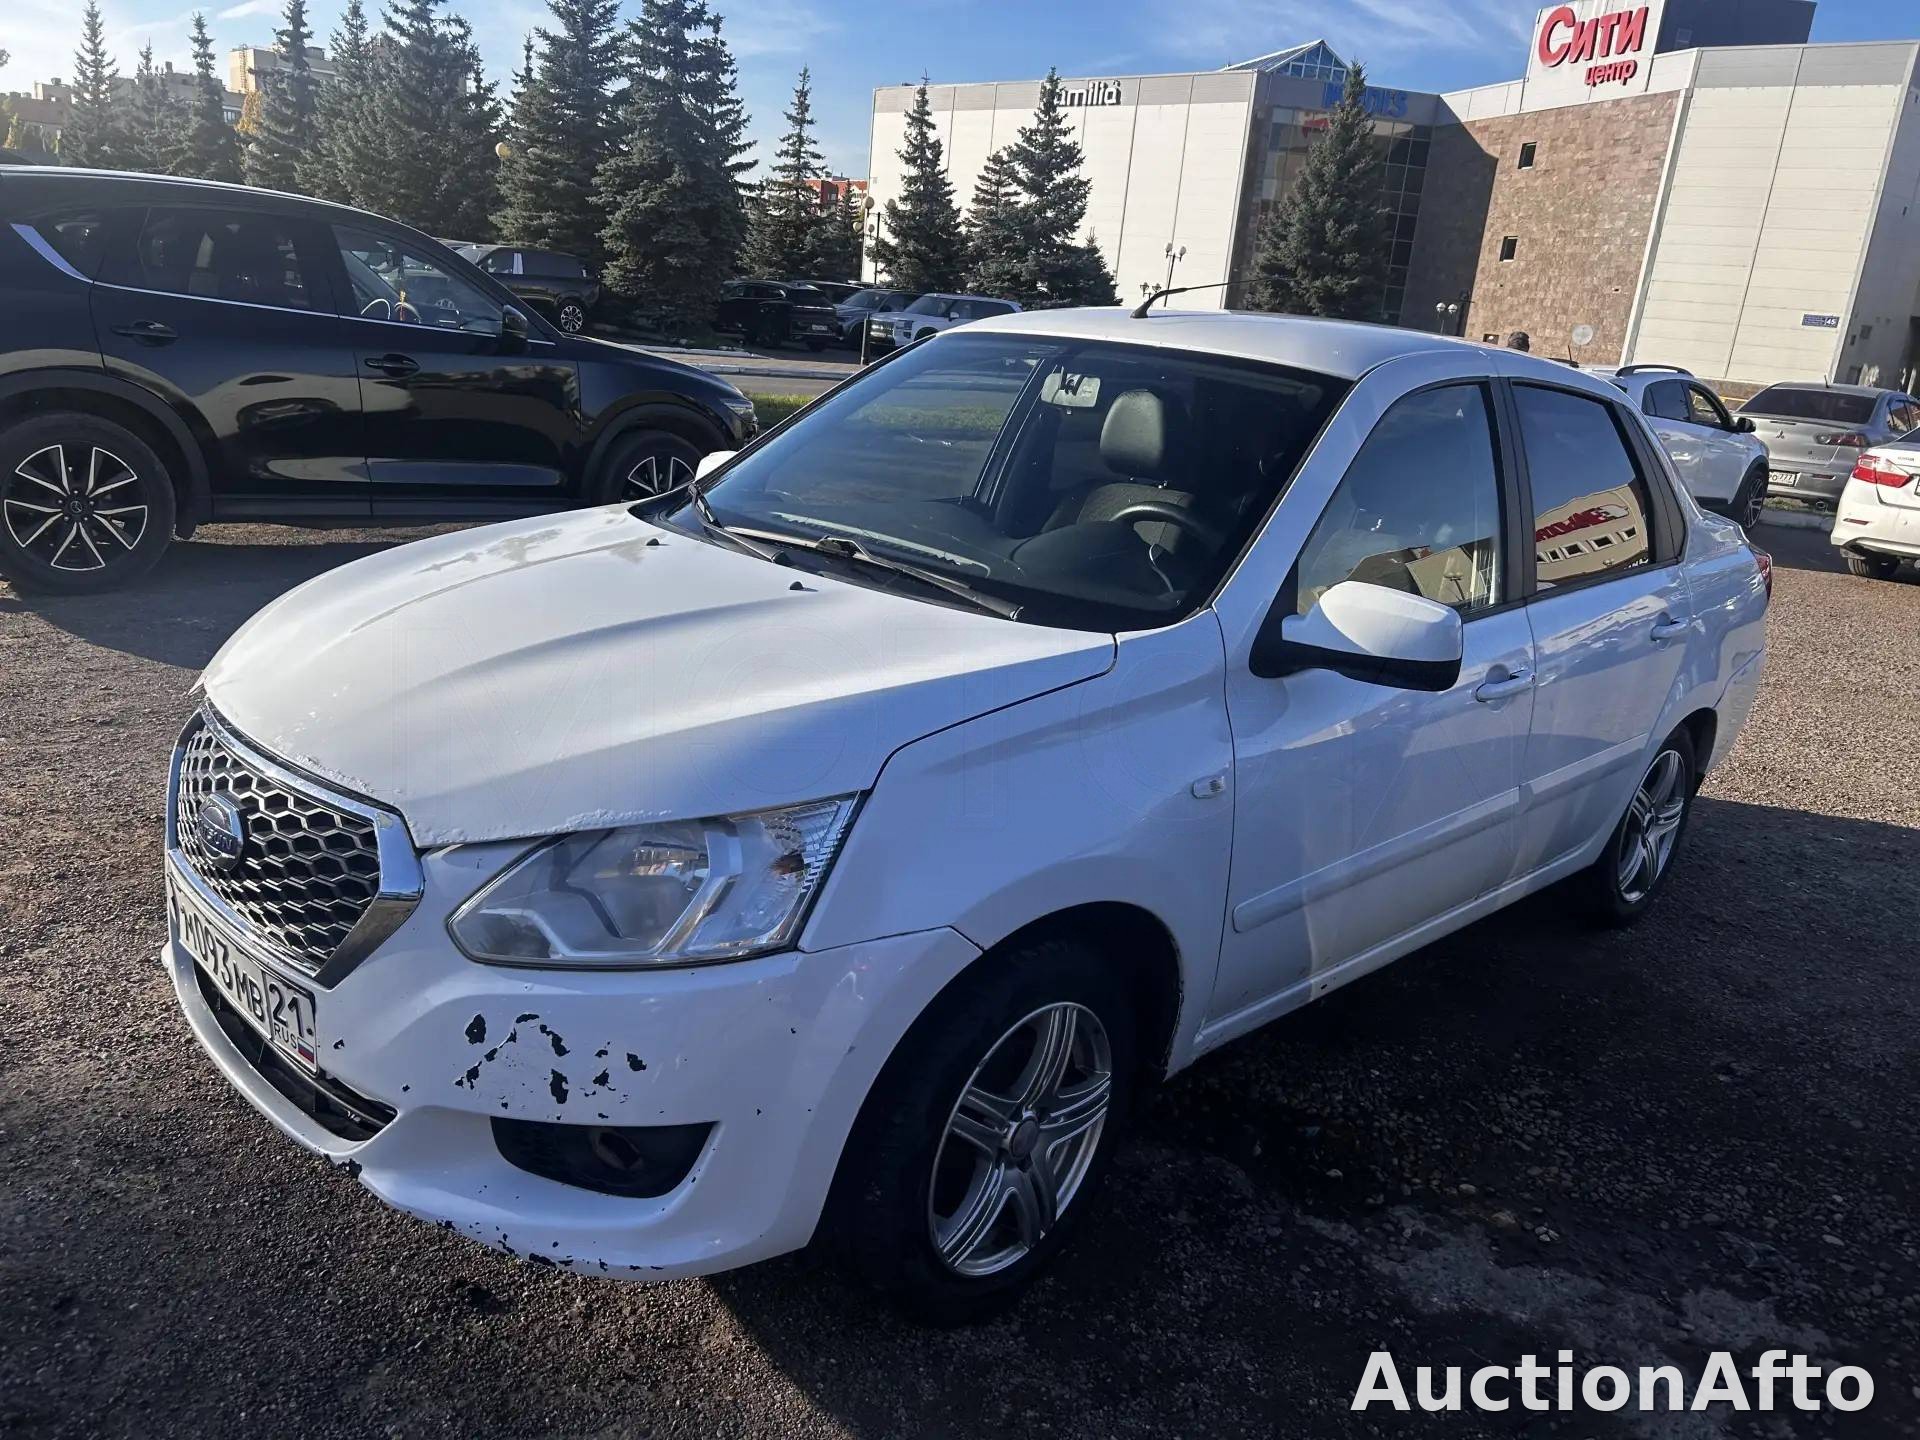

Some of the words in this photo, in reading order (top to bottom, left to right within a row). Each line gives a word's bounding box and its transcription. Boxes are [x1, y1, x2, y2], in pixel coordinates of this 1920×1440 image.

[1538, 5, 1649, 67] Сити
[1584, 60, 1637, 87] центр
[1046, 80, 1121, 106] amilia
[269, 982, 304, 1038] 21
[274, 1022, 298, 1050] RUS
